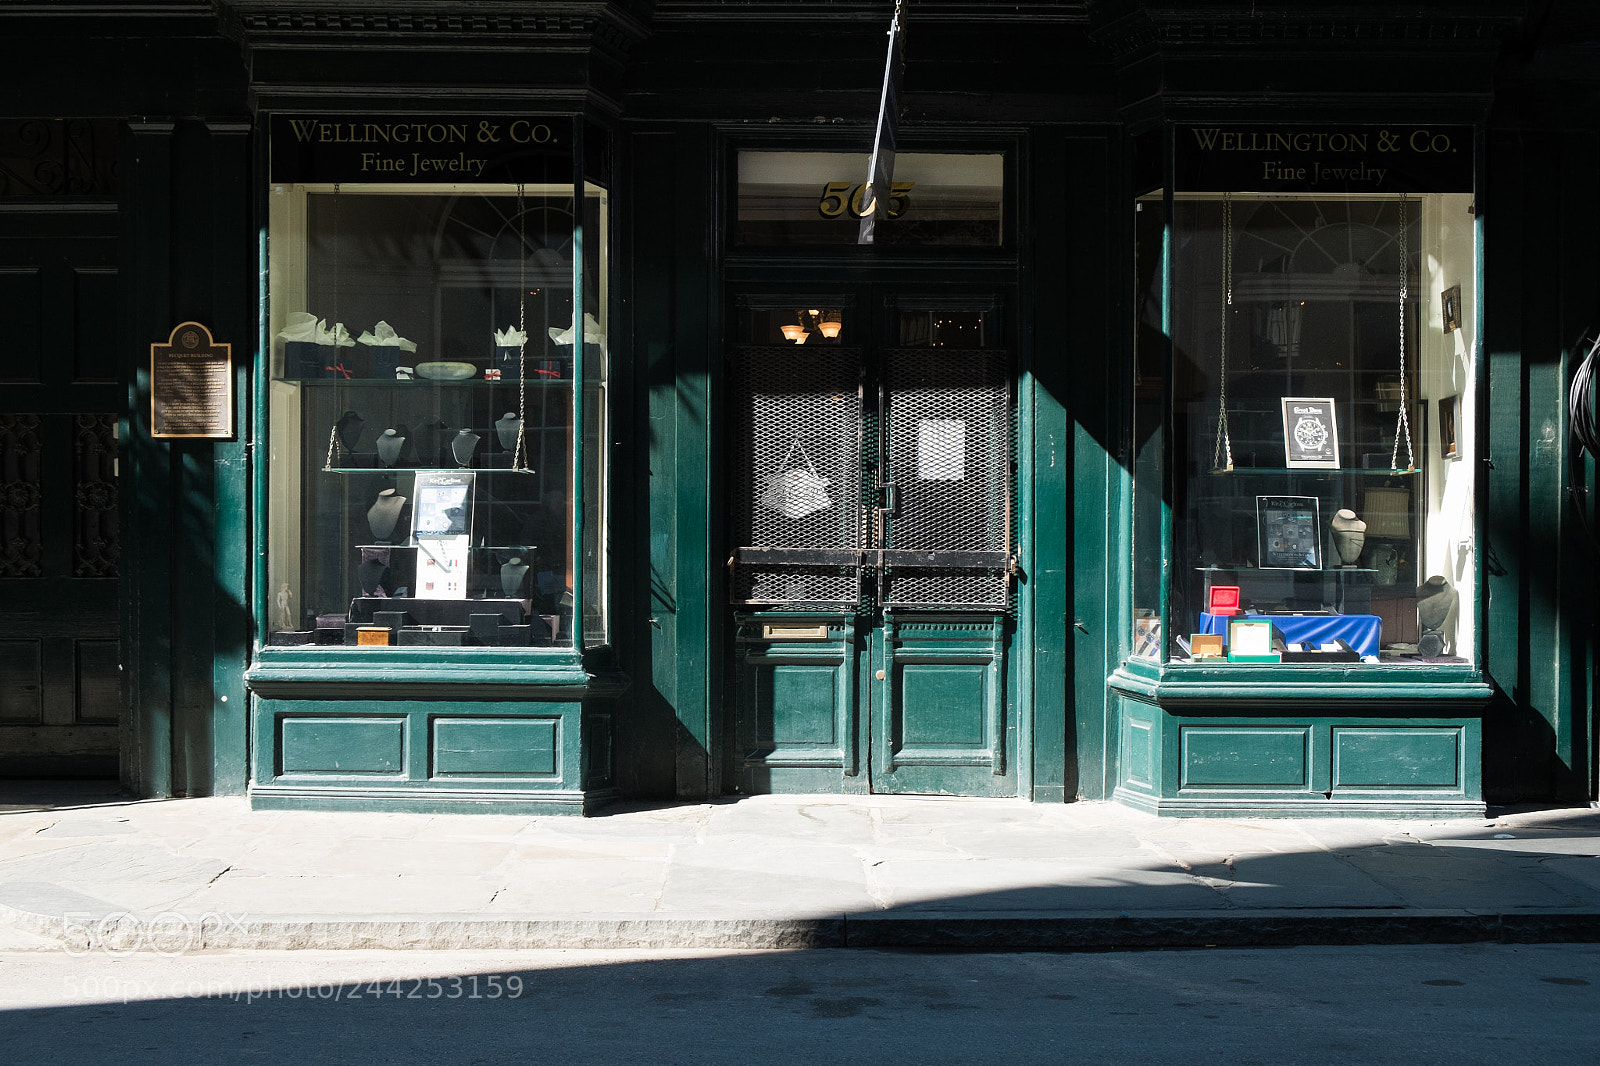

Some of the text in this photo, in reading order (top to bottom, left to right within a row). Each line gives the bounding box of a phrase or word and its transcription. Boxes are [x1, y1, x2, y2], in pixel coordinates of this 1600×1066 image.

[288, 119, 469, 144] WELLINGTON
[476, 120, 501, 143] &
[1191, 128, 1369, 152] WELLINGTON
[1377, 129, 1401, 152] &
[360, 152, 488, 177] Fine Jewelry
[1262, 161, 1388, 185] Fine Jewelry
[818, 181, 915, 220] 505
